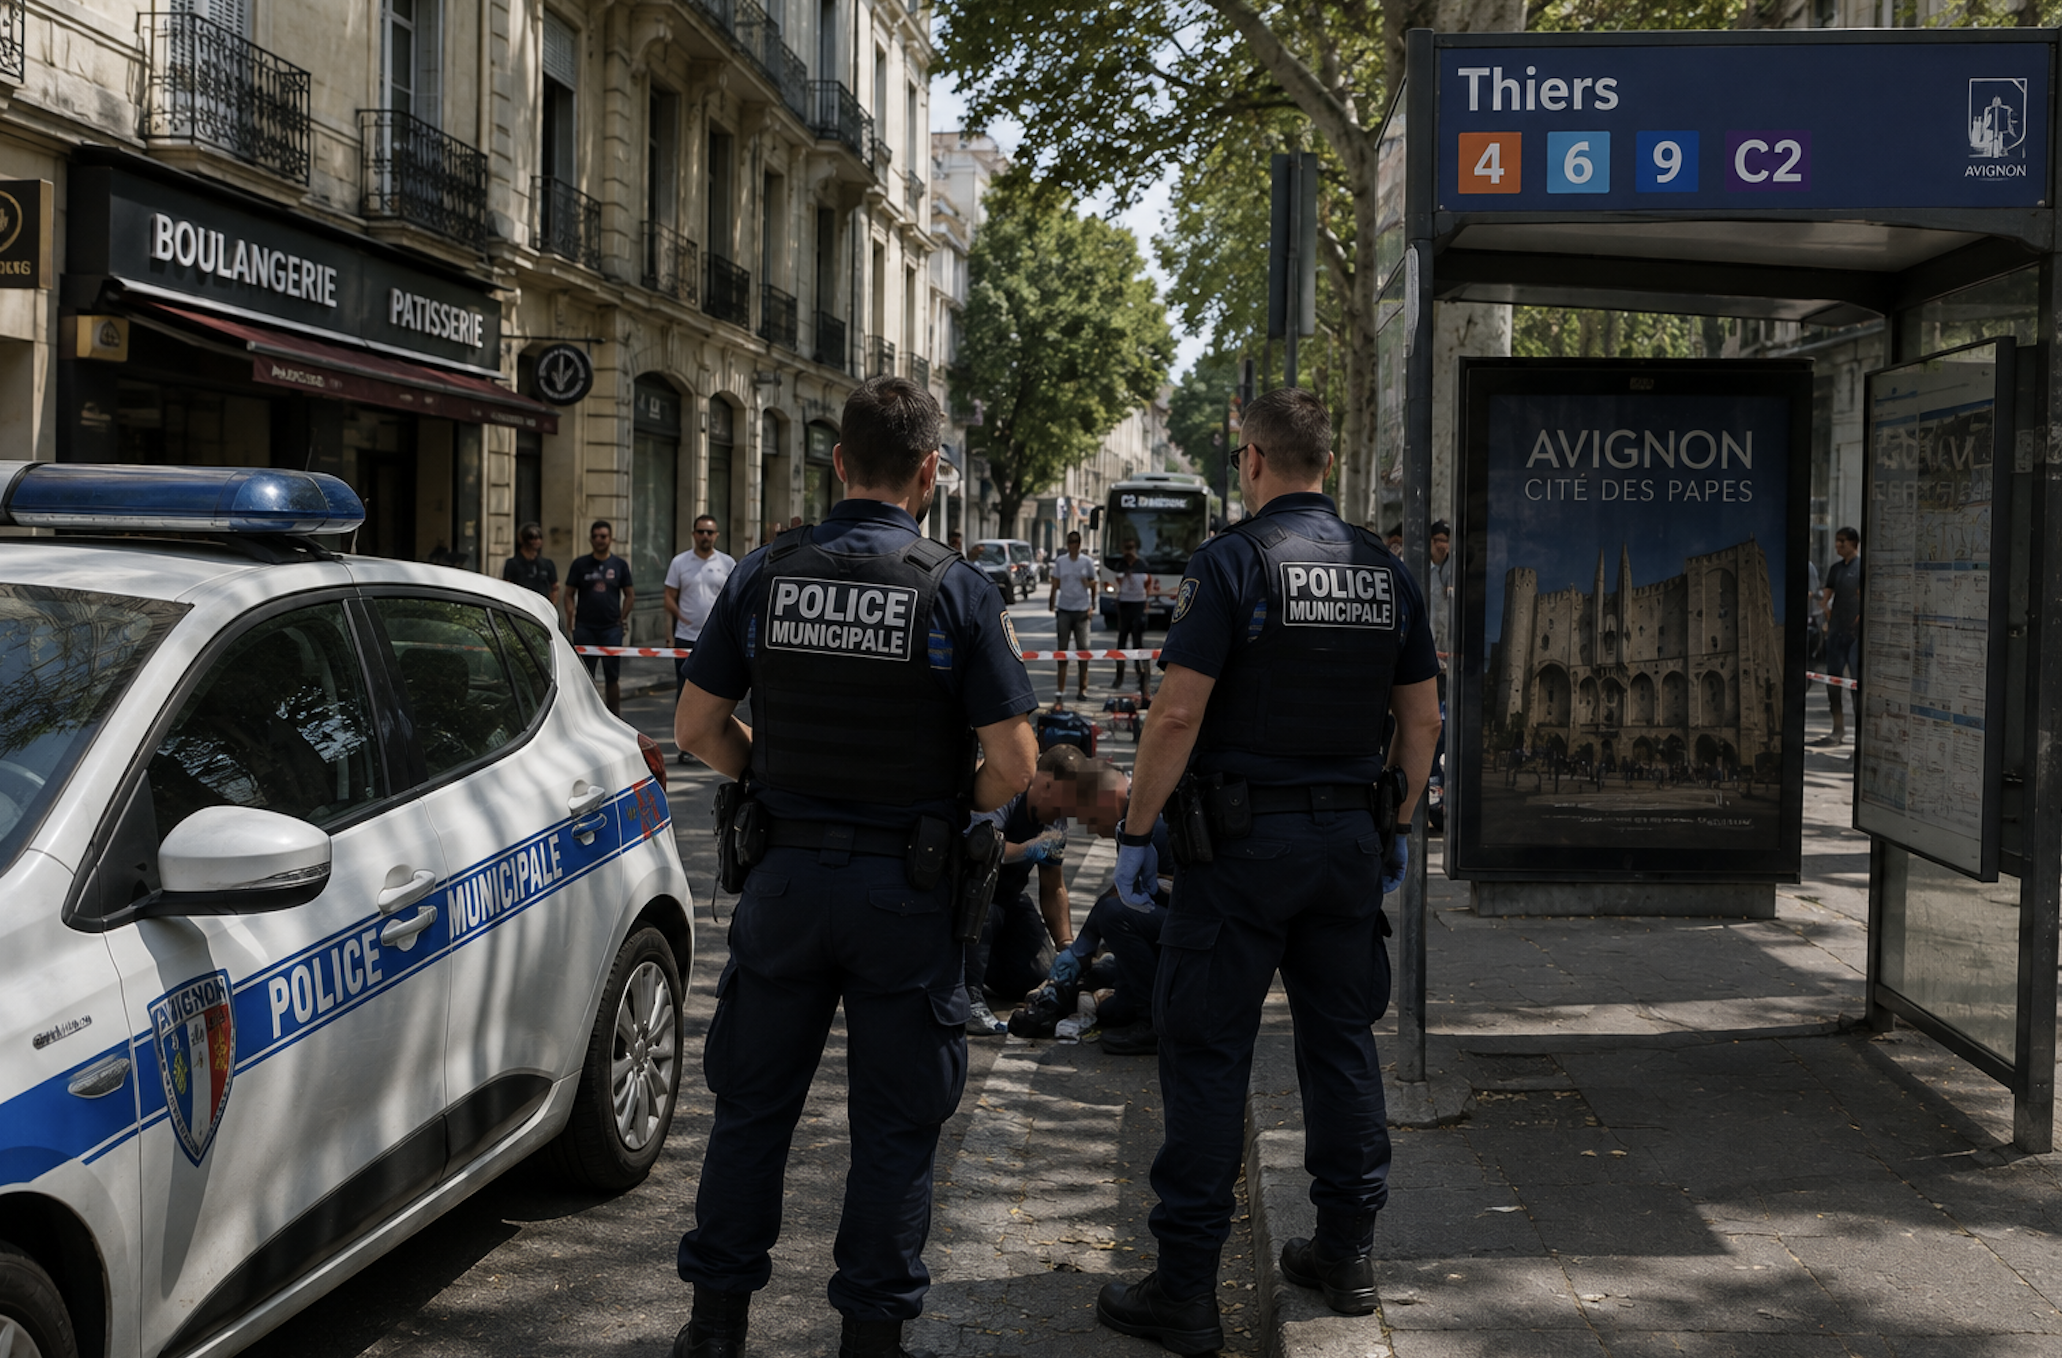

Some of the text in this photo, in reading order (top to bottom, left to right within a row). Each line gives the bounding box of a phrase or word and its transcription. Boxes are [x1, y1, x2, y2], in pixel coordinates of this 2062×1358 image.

[1458, 66, 1619, 111] Thiers
[1473, 139, 1802, 183] 4 6 9 C2
[1964, 165, 2027, 177] AVIGNON
[151, 212, 337, 308] BOULANGERIE
[389, 287, 483, 348] PATISSERIE
[1526, 429, 1752, 469] AVIGNON
[1525, 471, 1753, 503] CITÉ DES PAPES
[775, 583, 908, 627] POLICE
[1287, 567, 1391, 601] POLICE
[1289, 600, 1391, 625] MUNICIPALE
[772, 620, 905, 654] MUNICIPALE
[269, 834, 562, 1038] POLICE MUNICIPALE
